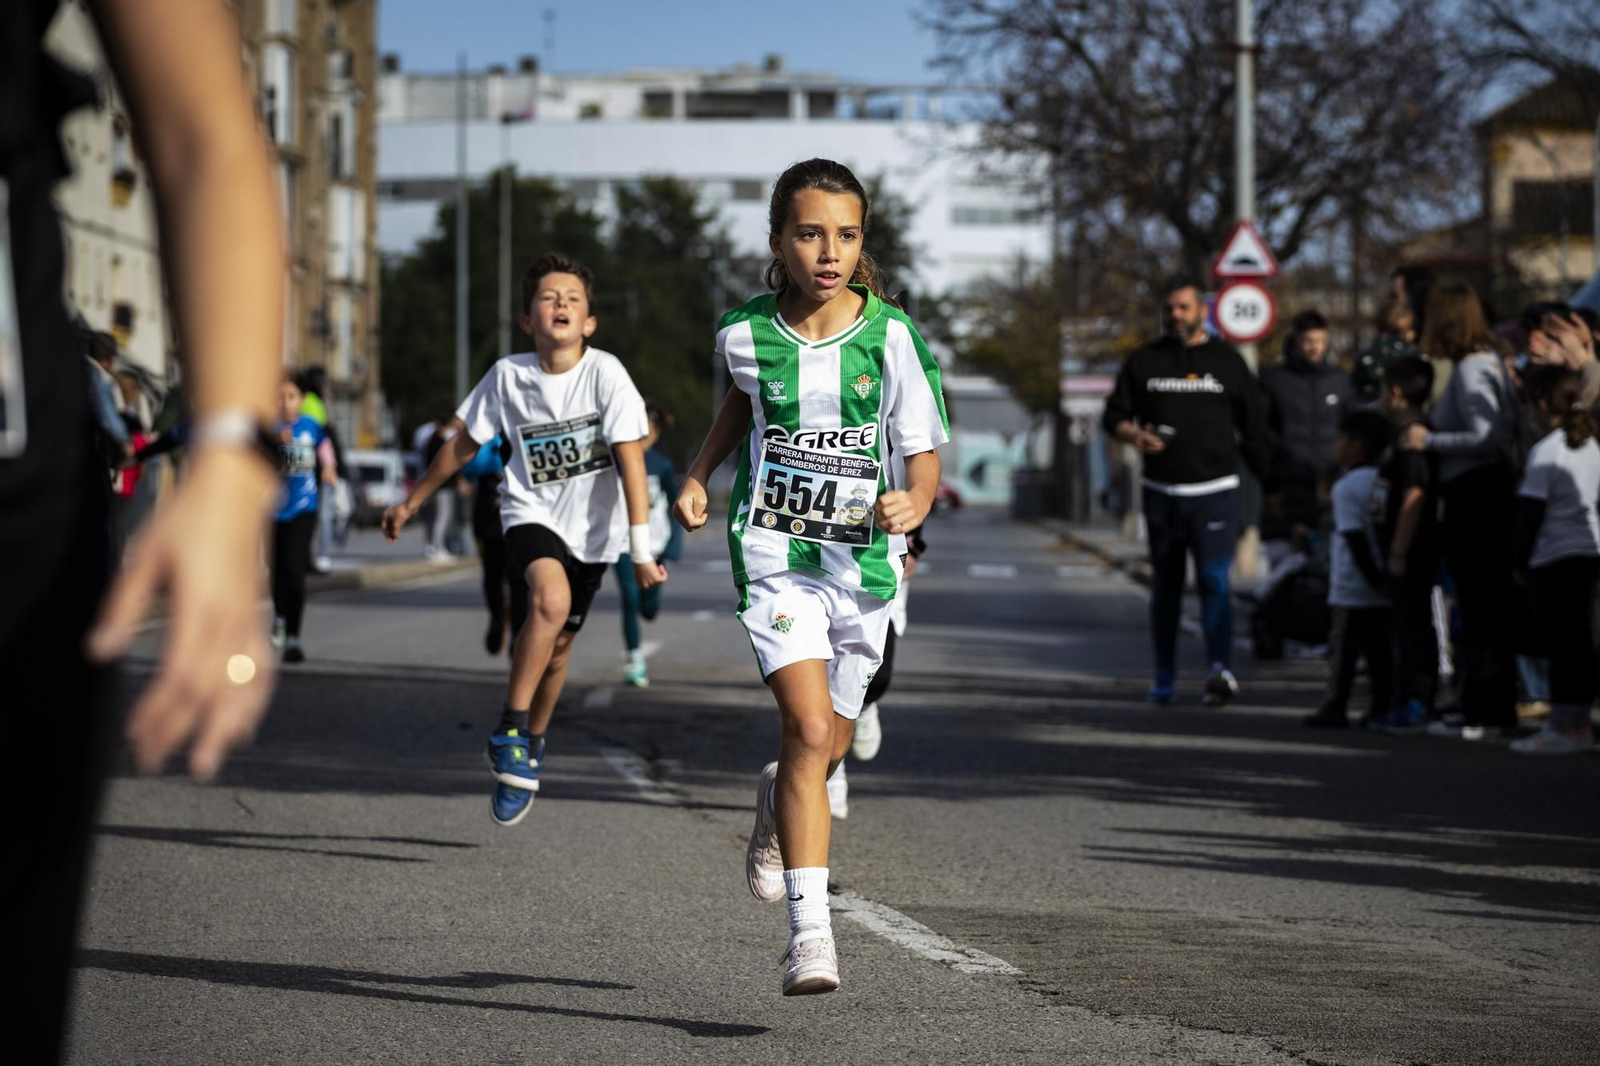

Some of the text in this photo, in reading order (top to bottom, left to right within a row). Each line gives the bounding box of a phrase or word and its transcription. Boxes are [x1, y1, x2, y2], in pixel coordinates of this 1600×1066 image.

[793, 425, 876, 449] GREE
[528, 437, 580, 470] 533
[767, 444, 803, 460] CARRERA
[804, 453, 840, 466] INFANTIL
[780, 456, 862, 477] BOMBEROS DE JEREZ
[763, 468, 838, 520] 554
